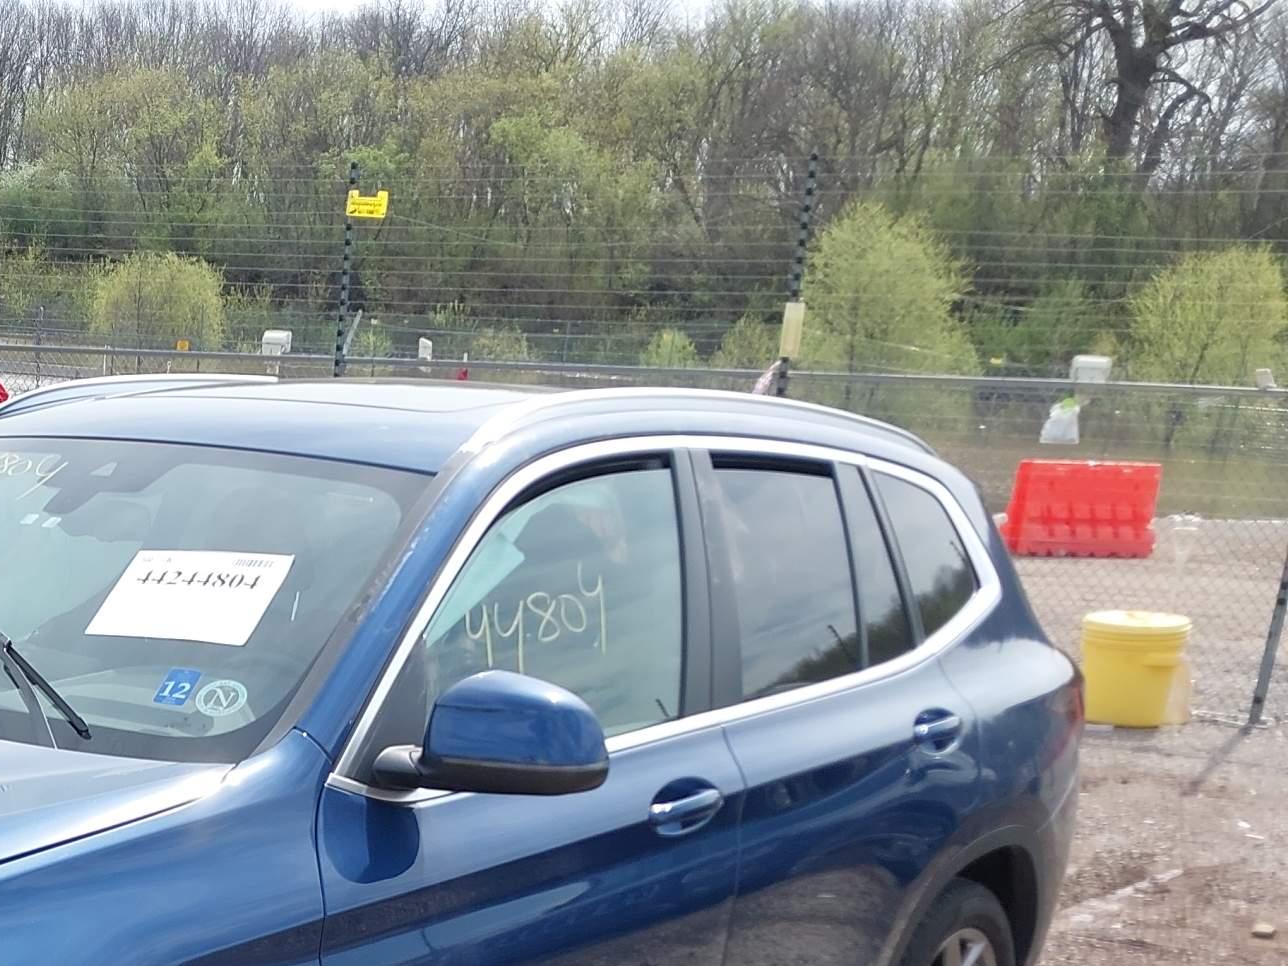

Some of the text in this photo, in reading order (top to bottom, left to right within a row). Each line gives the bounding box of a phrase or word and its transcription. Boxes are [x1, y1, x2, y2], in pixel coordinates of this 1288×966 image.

[136, 568, 262, 590] 44244804
[465, 560, 607, 675] 44804
[158, 680, 192, 700] 12
